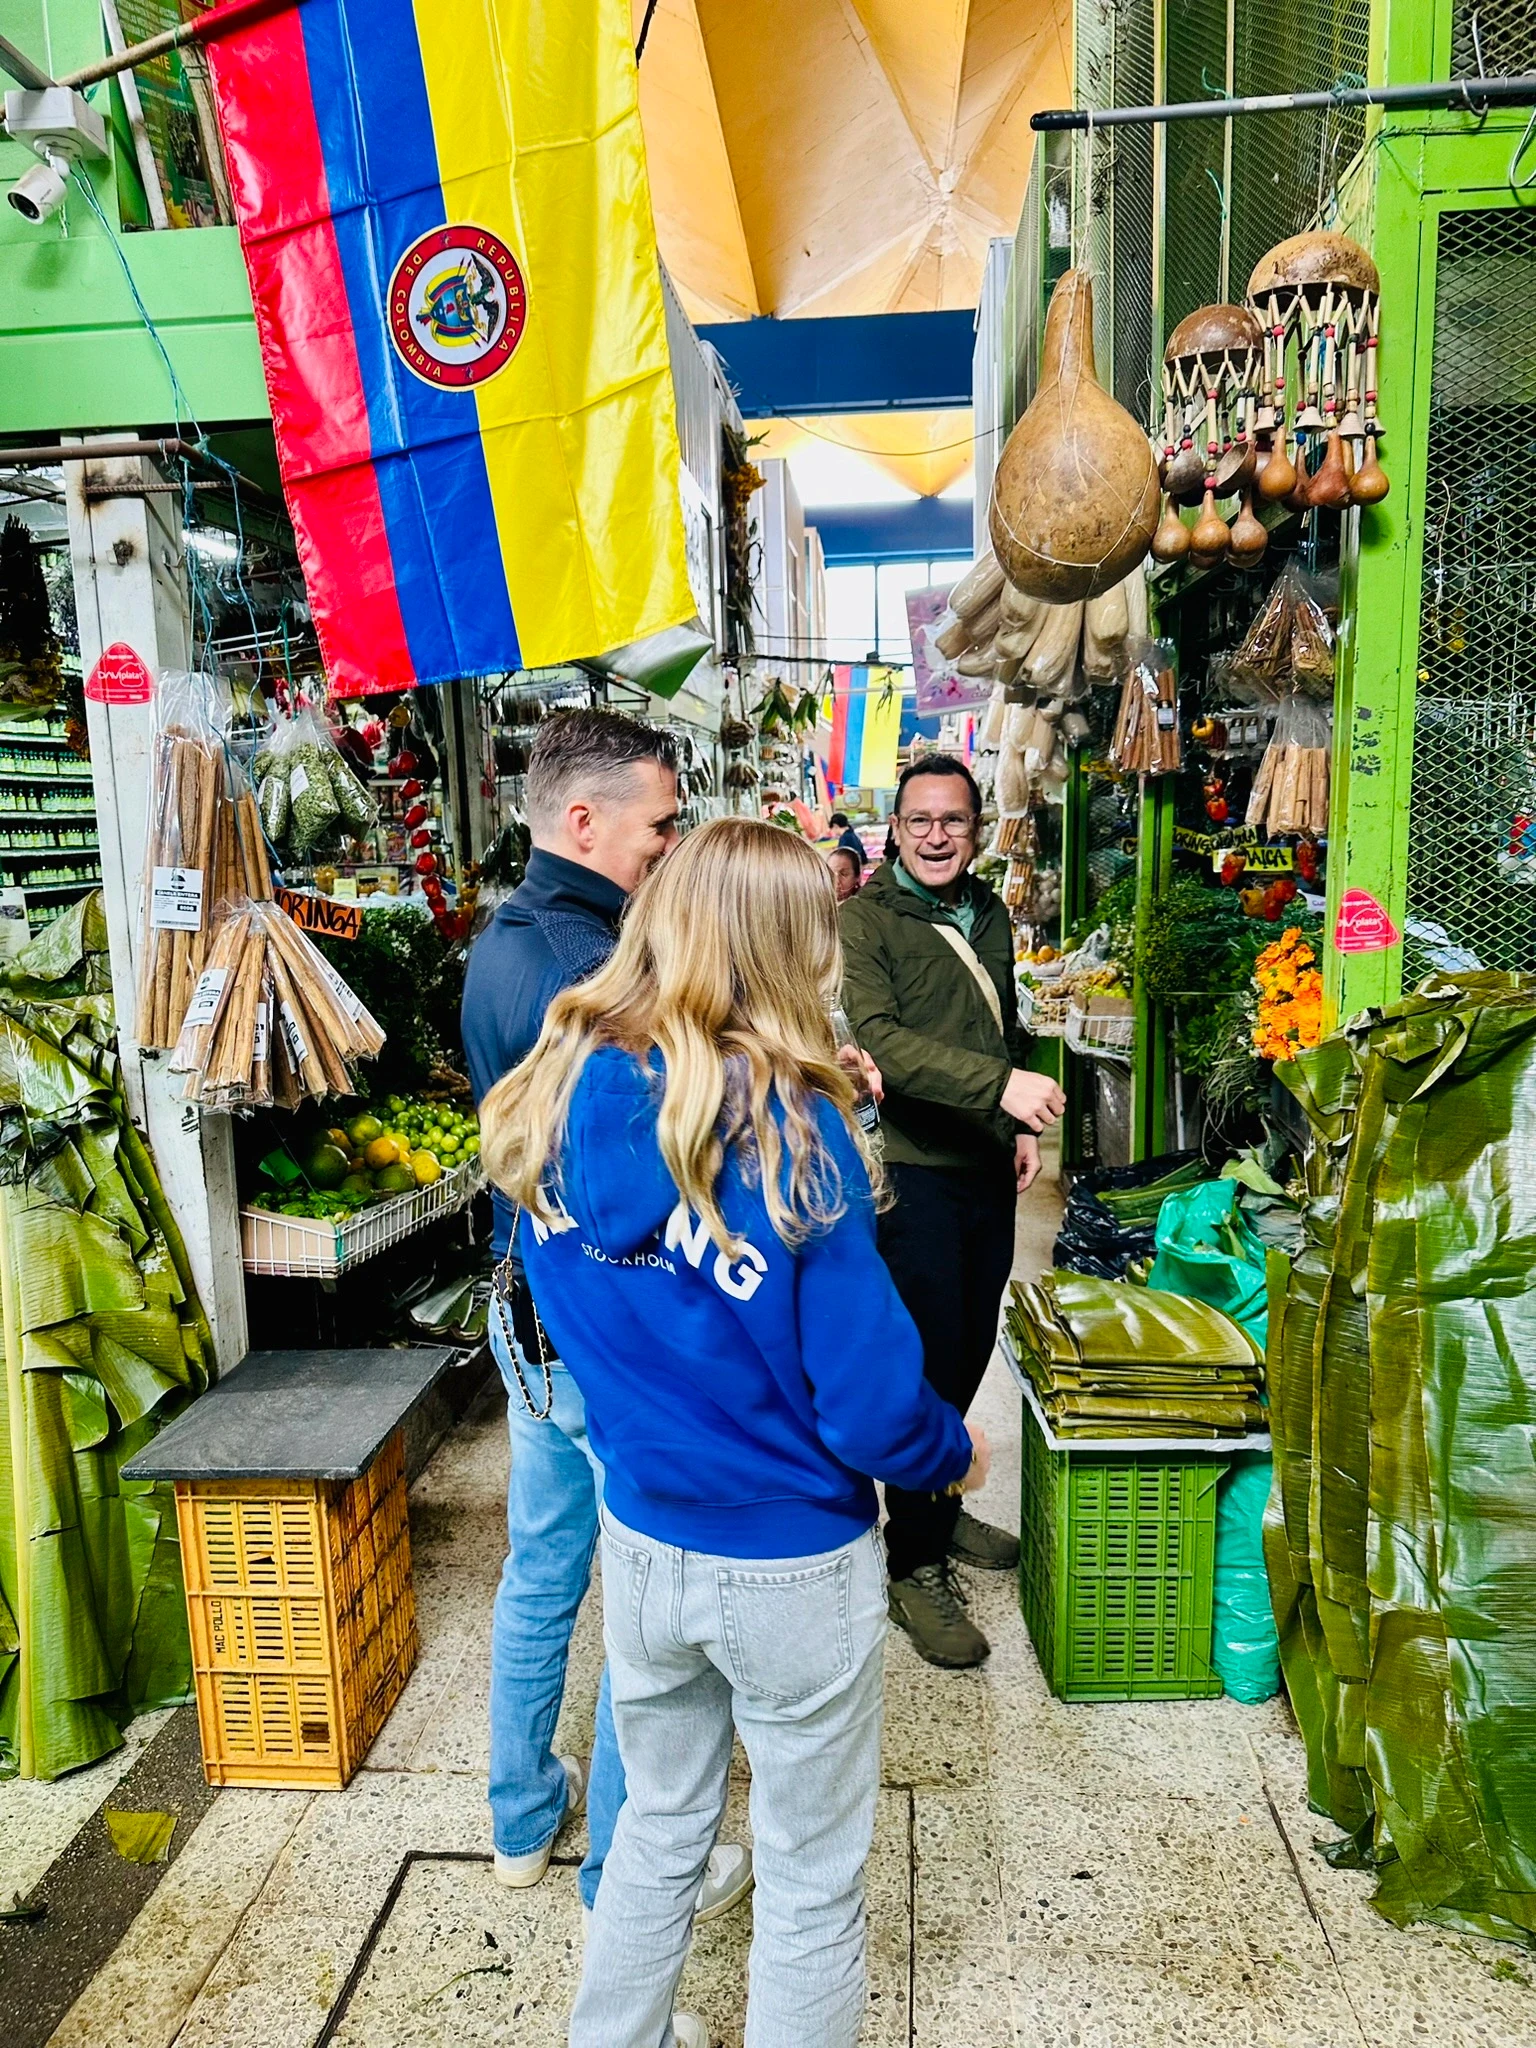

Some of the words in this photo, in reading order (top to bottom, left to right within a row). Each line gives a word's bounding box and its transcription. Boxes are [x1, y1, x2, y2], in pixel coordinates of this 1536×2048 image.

[405, 253, 423, 276] DE
[477, 237, 521, 351] REPUBLICA
[395, 289, 441, 377] COLOMBIA
[211, 1601, 223, 1631] POLLO
[214, 1635, 226, 1653] MAC
